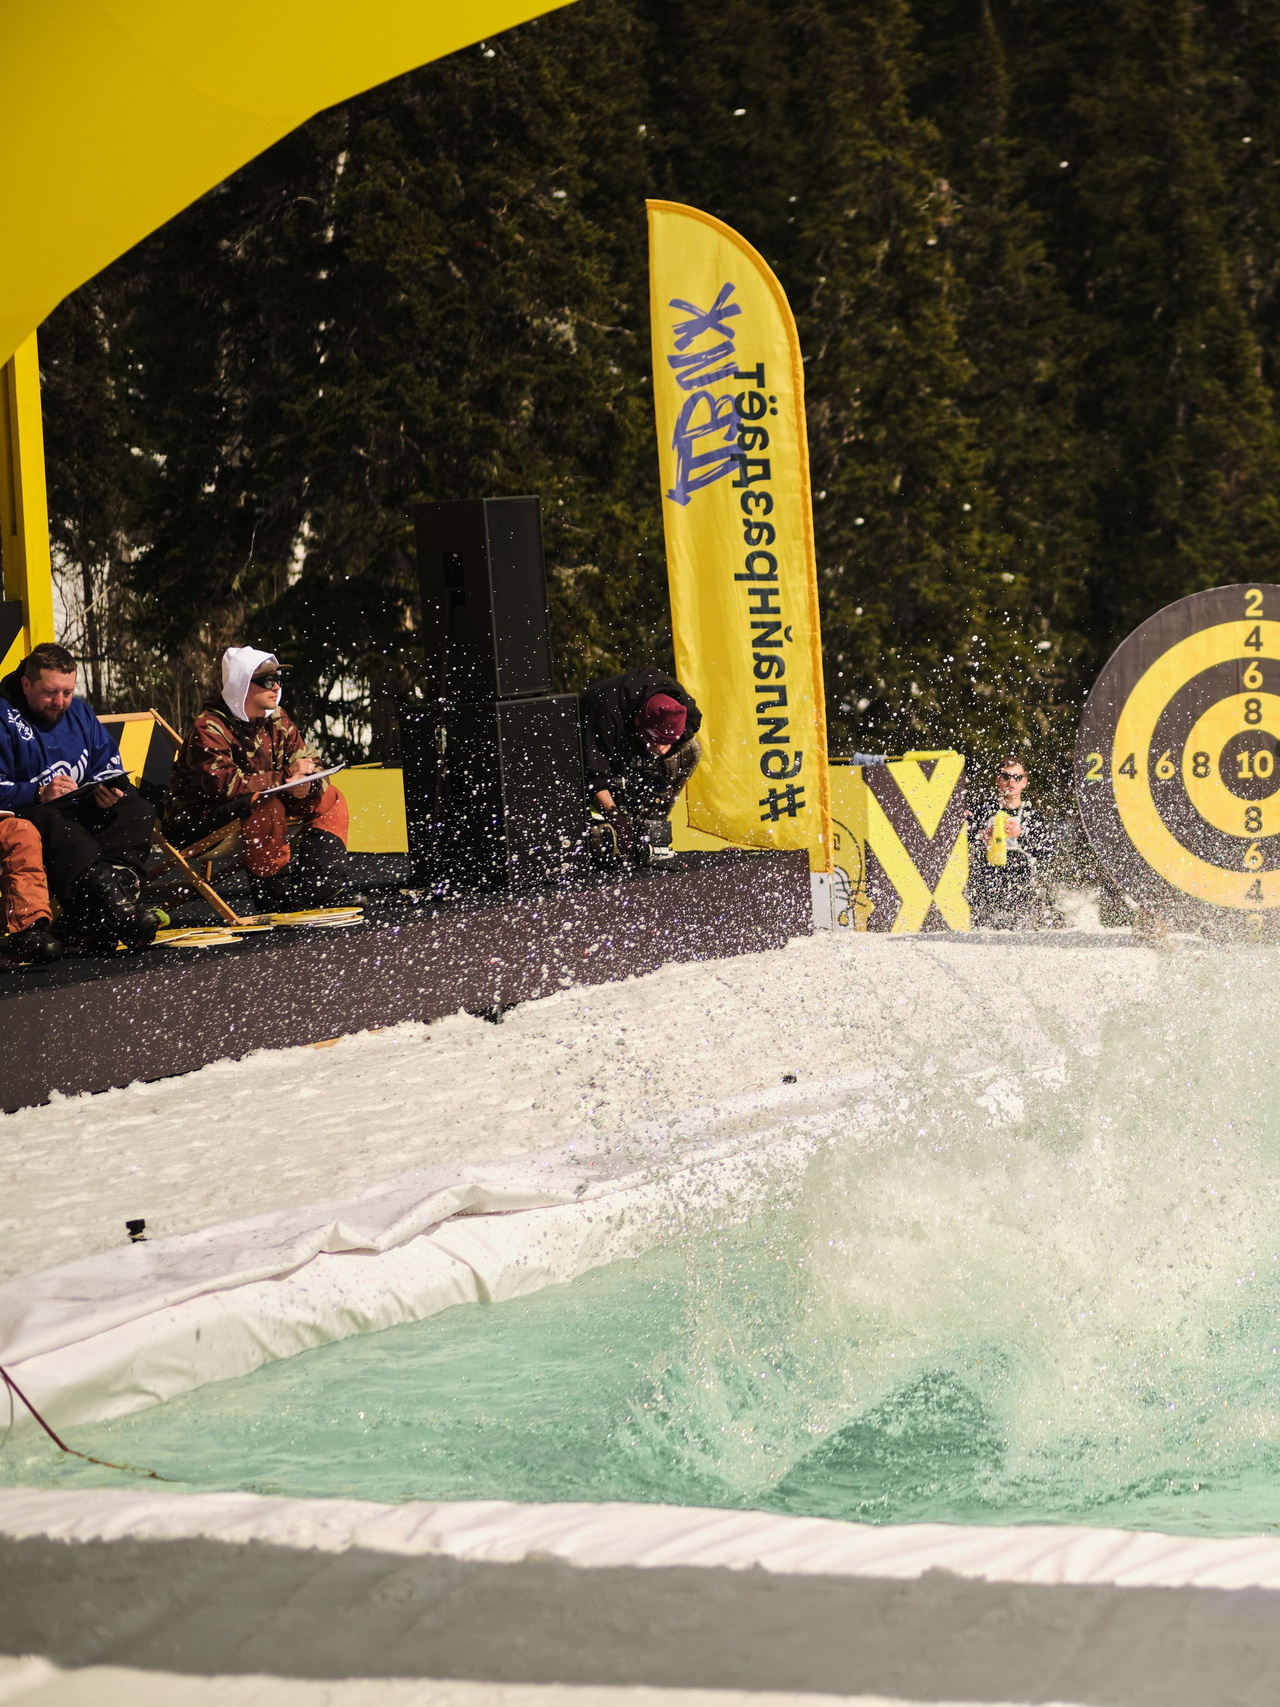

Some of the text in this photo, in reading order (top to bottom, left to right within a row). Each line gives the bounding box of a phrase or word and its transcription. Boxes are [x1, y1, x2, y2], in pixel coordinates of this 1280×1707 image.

[1245, 589, 1263, 617] 2
[1244, 625, 1263, 652] 4
[1243, 662, 1263, 690] 6
[1243, 698, 1263, 725] 8
[1085, 752, 1104, 780] 2
[1118, 753, 1138, 779] 4
[1156, 752, 1175, 780] 6
[1192, 751, 1211, 778] 8
[1236, 750, 1274, 779] 10
[1244, 806, 1264, 833] 8
[1244, 842, 1264, 870] 6
[1245, 878, 1264, 904] 4
